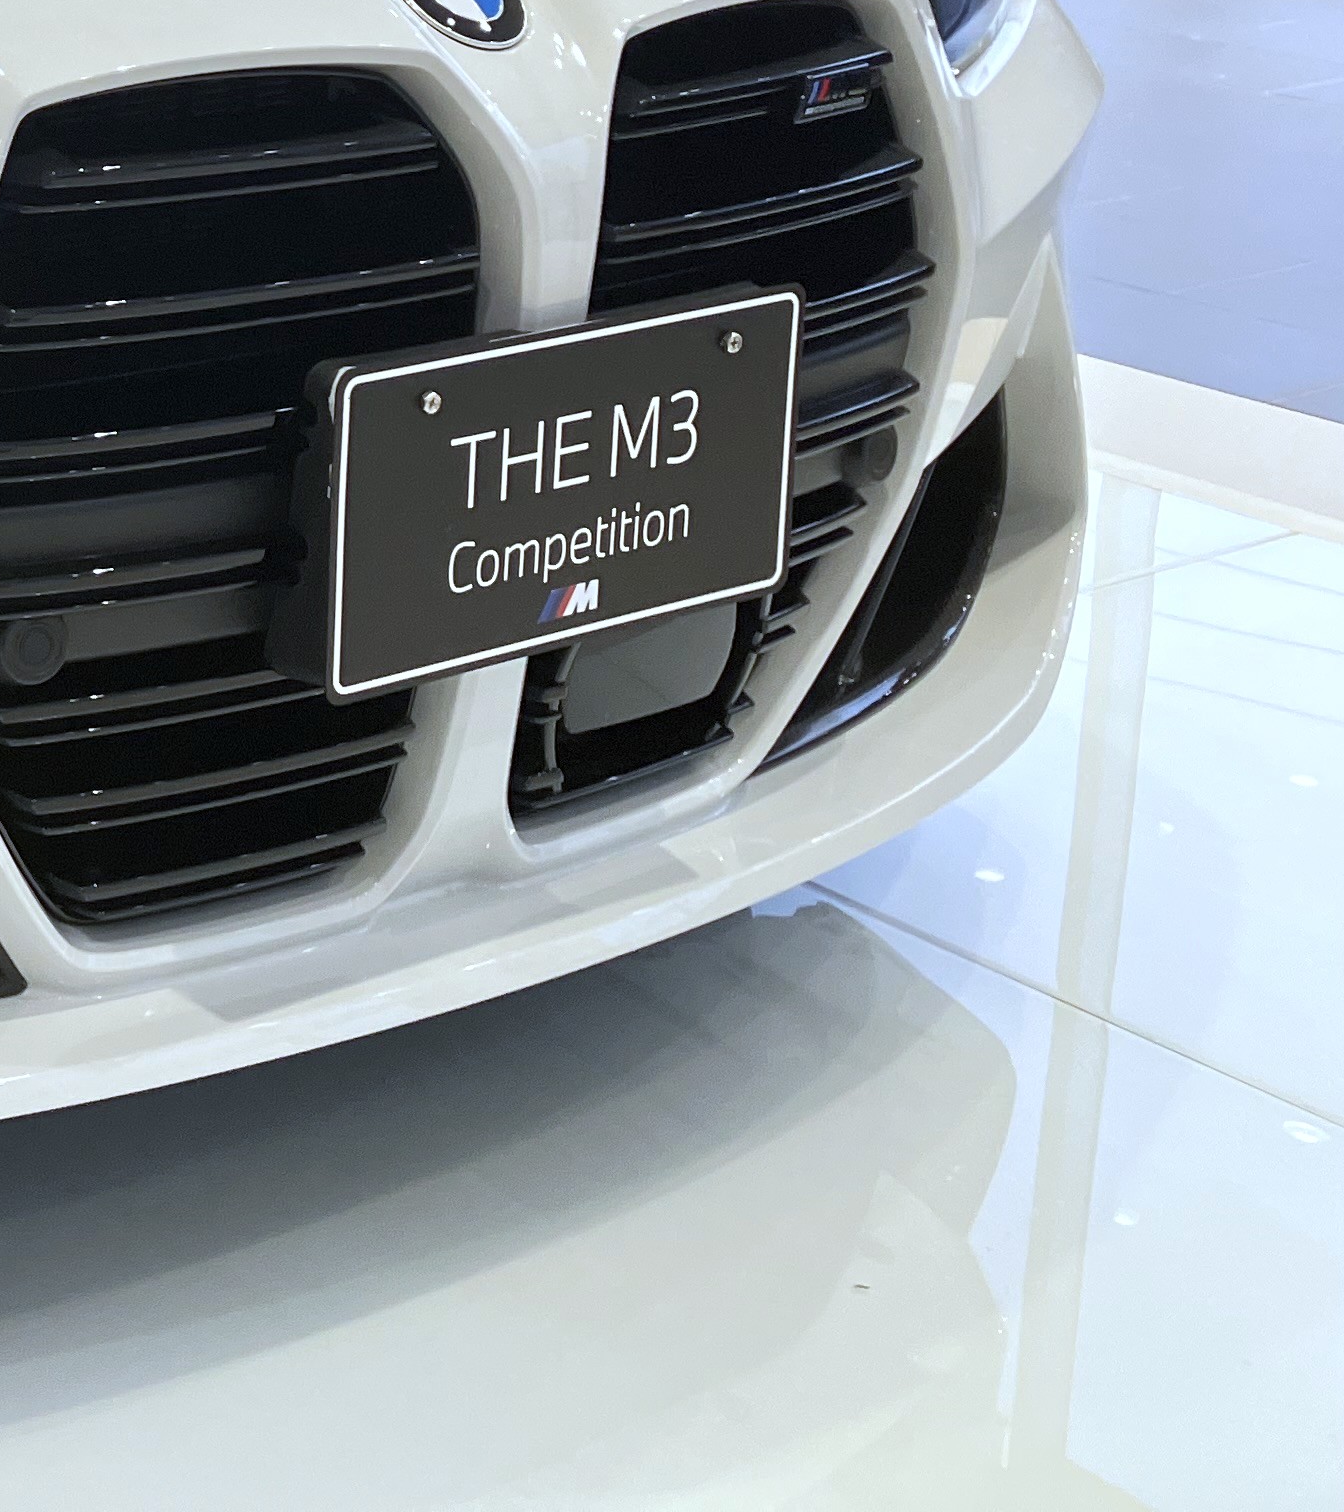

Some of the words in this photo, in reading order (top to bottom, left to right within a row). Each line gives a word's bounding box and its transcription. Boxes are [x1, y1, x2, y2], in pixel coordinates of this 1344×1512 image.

[450, 409, 593, 509] THE
[610, 389, 700, 478] M3
[448, 501, 690, 594] Competition
